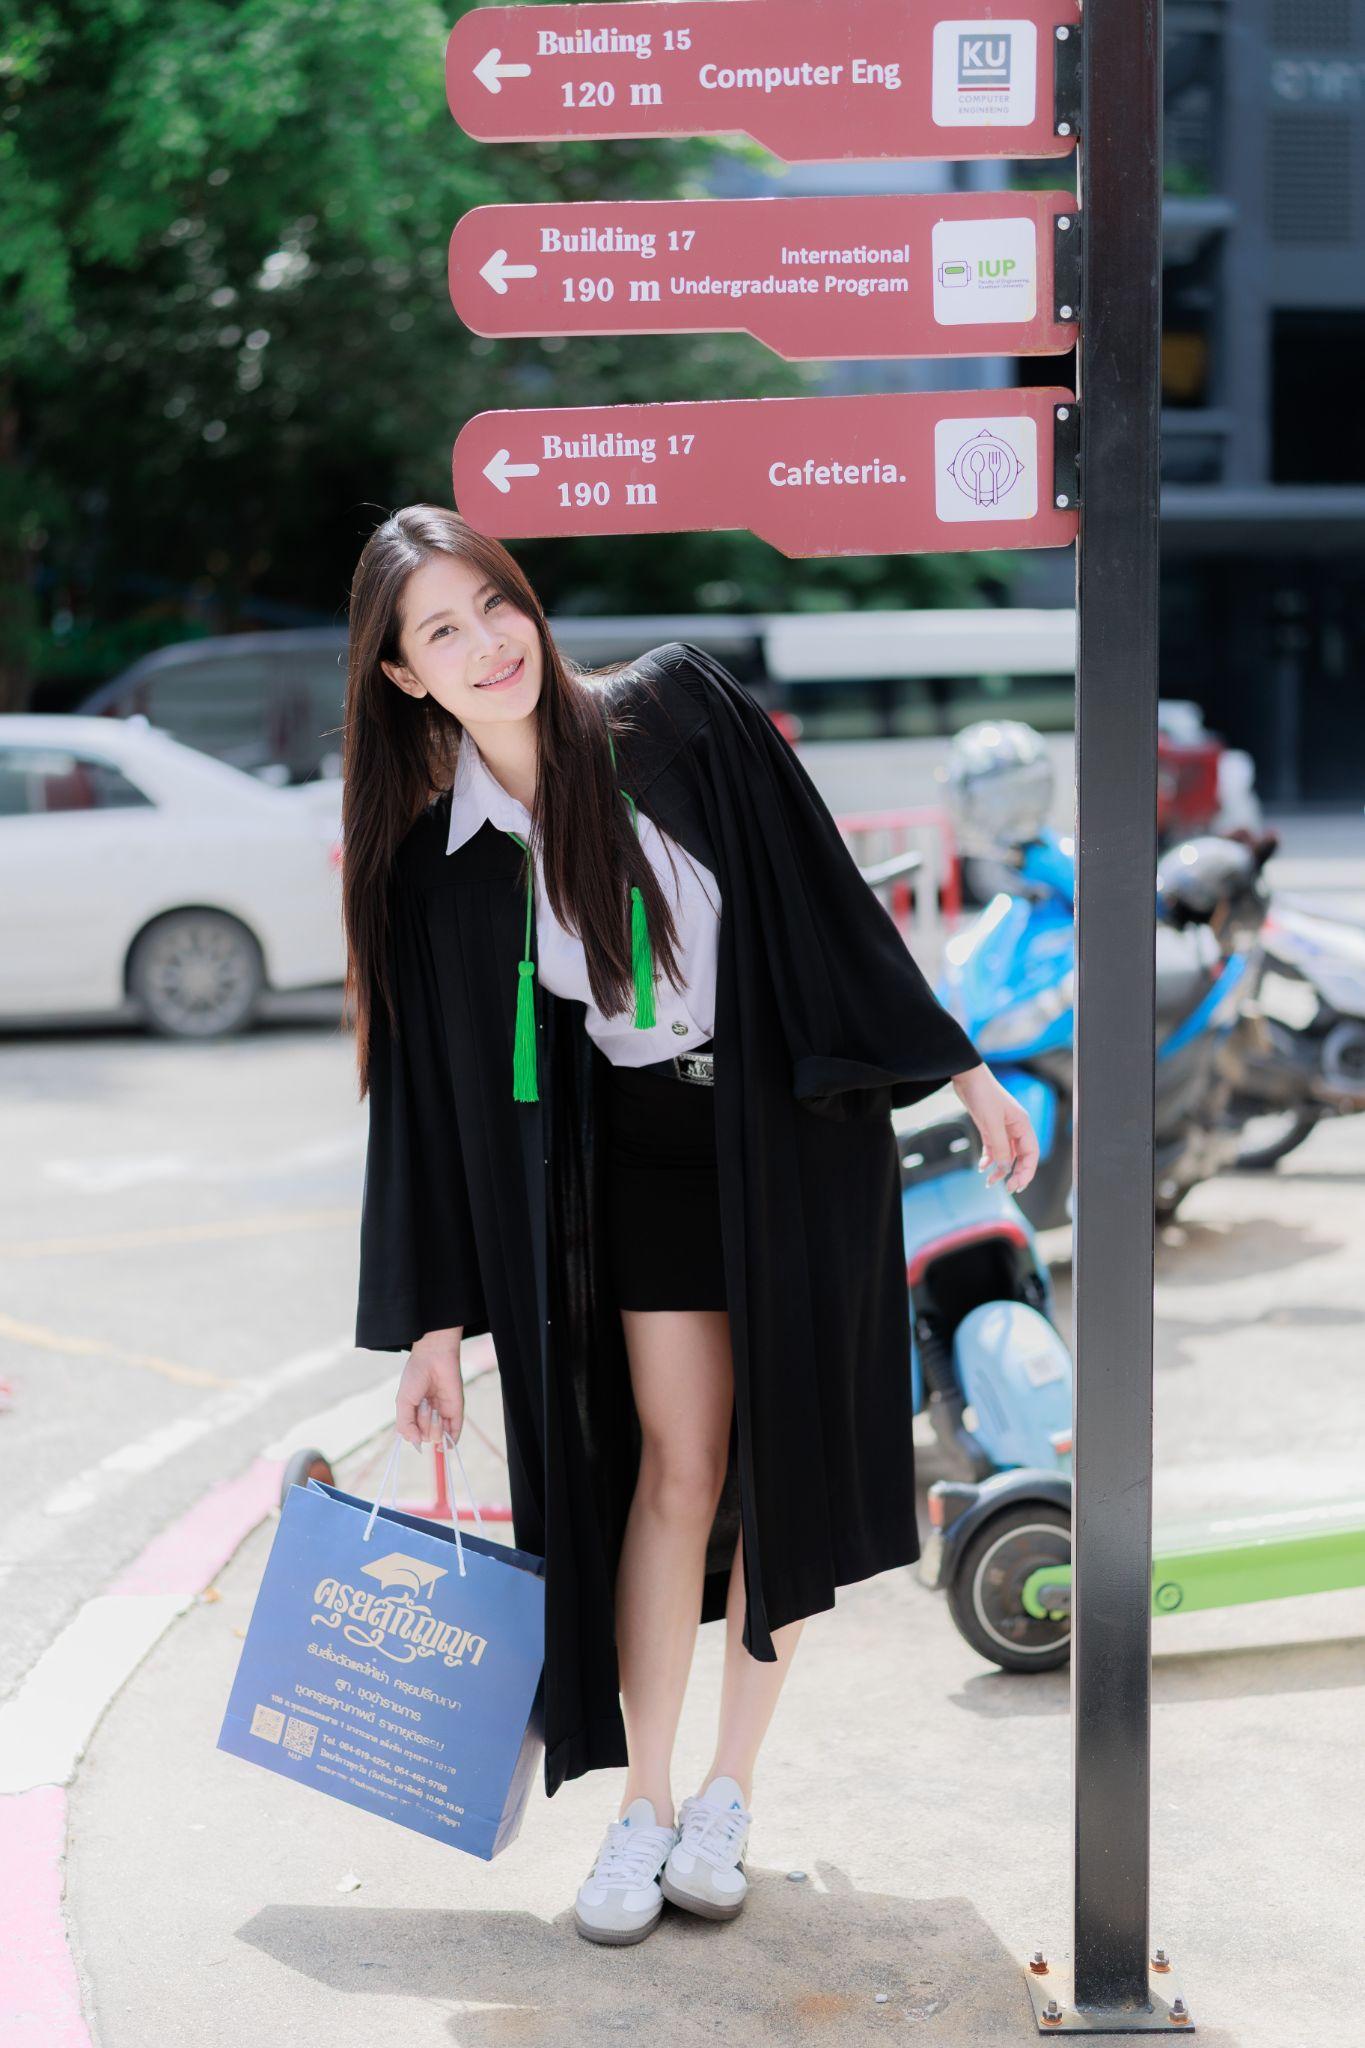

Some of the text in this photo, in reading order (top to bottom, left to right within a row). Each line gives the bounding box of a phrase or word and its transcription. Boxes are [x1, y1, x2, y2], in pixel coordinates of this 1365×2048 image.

[537, 28, 691, 59] Building 15
[963, 41, 1005, 67] KU
[700, 59, 901, 92] Computer Eng
[562, 82, 662, 107] 120 m
[959, 96, 1010, 104] COMPUTER
[541, 227, 695, 258] Building 17
[782, 245, 909, 264] International
[978, 260, 1016, 278] IUP
[563, 278, 660, 302] 190 m
[671, 276, 908, 297] Undergraduate Program
[542, 433, 694, 463] Building 17
[769, 459, 906, 486] Cafeteria.
[558, 482, 657, 506] 190 m
[311, 1578, 487, 1667] ครุยสุกัญญา
